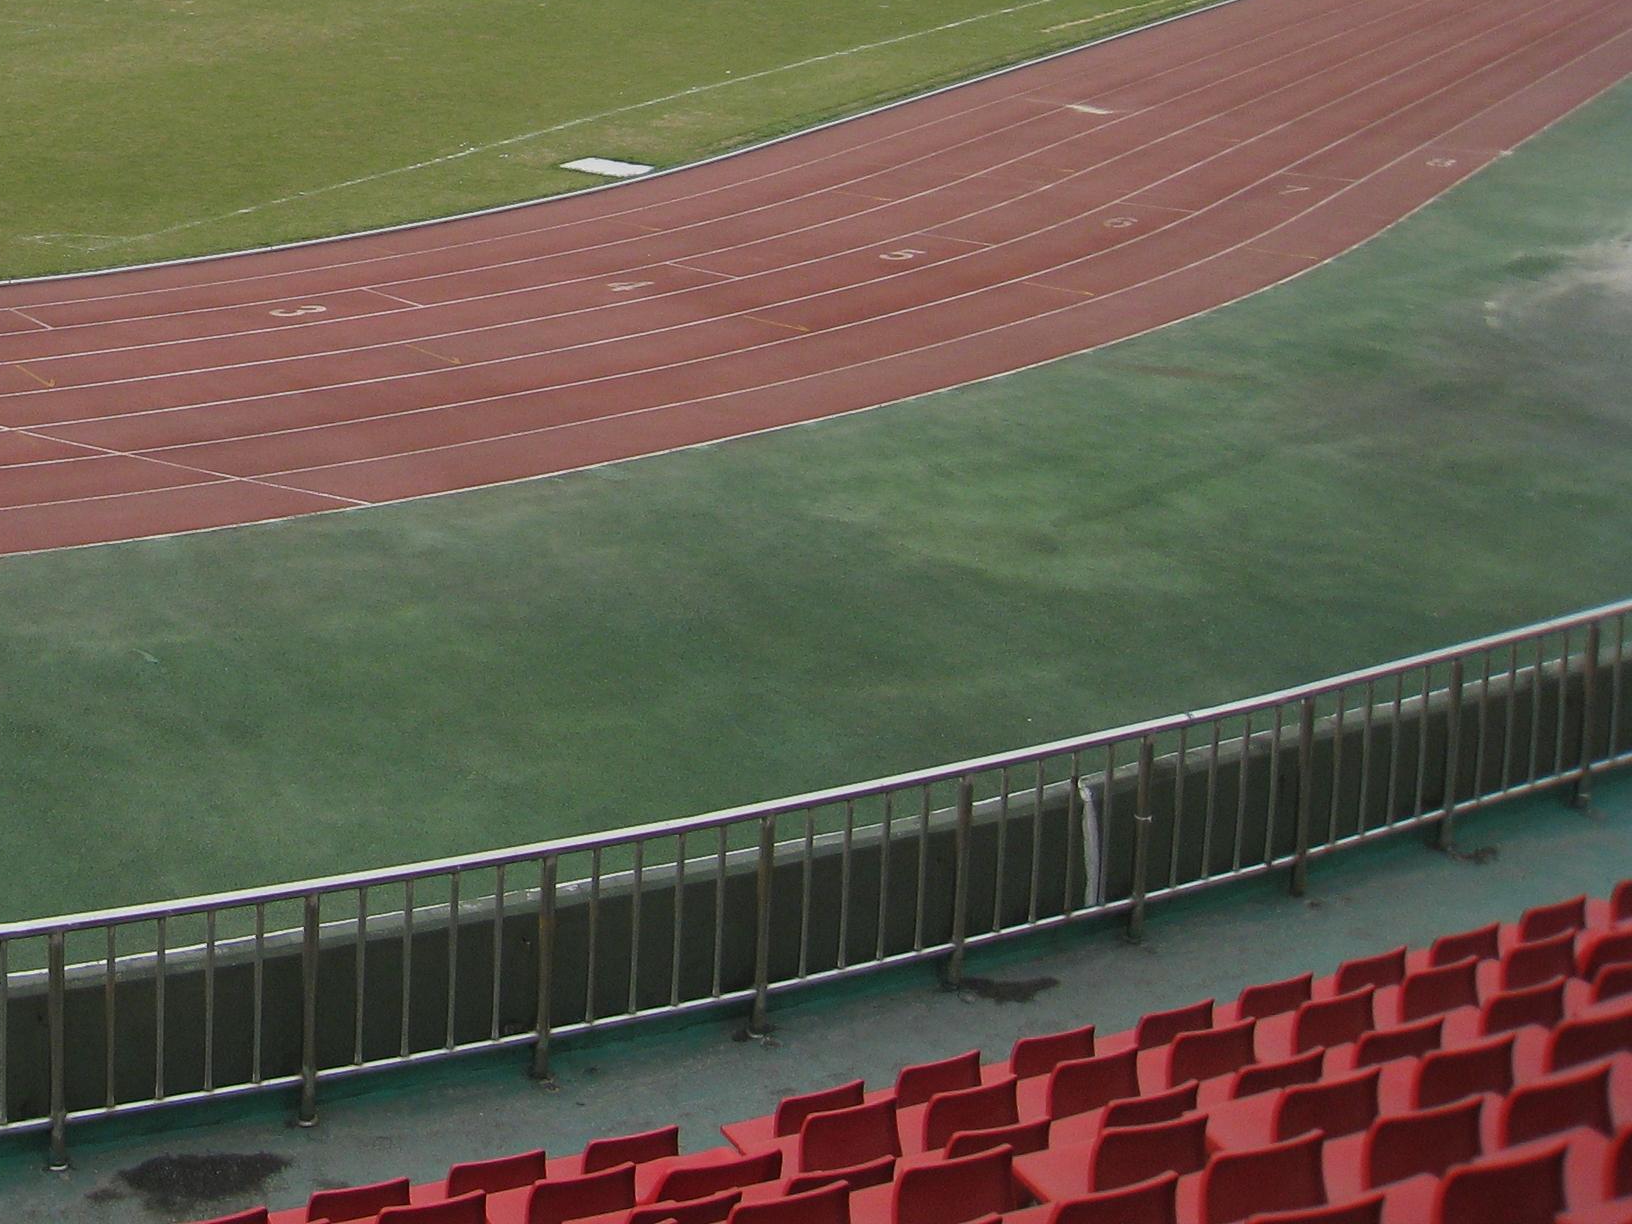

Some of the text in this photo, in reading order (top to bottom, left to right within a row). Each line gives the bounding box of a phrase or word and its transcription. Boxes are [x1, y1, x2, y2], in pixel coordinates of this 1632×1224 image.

[1279, 184, 1310, 195] 7
[1103, 216, 1139, 228] 6
[879, 248, 927, 261] 5
[607, 280, 656, 292] 4
[268, 304, 327, 317] 3
